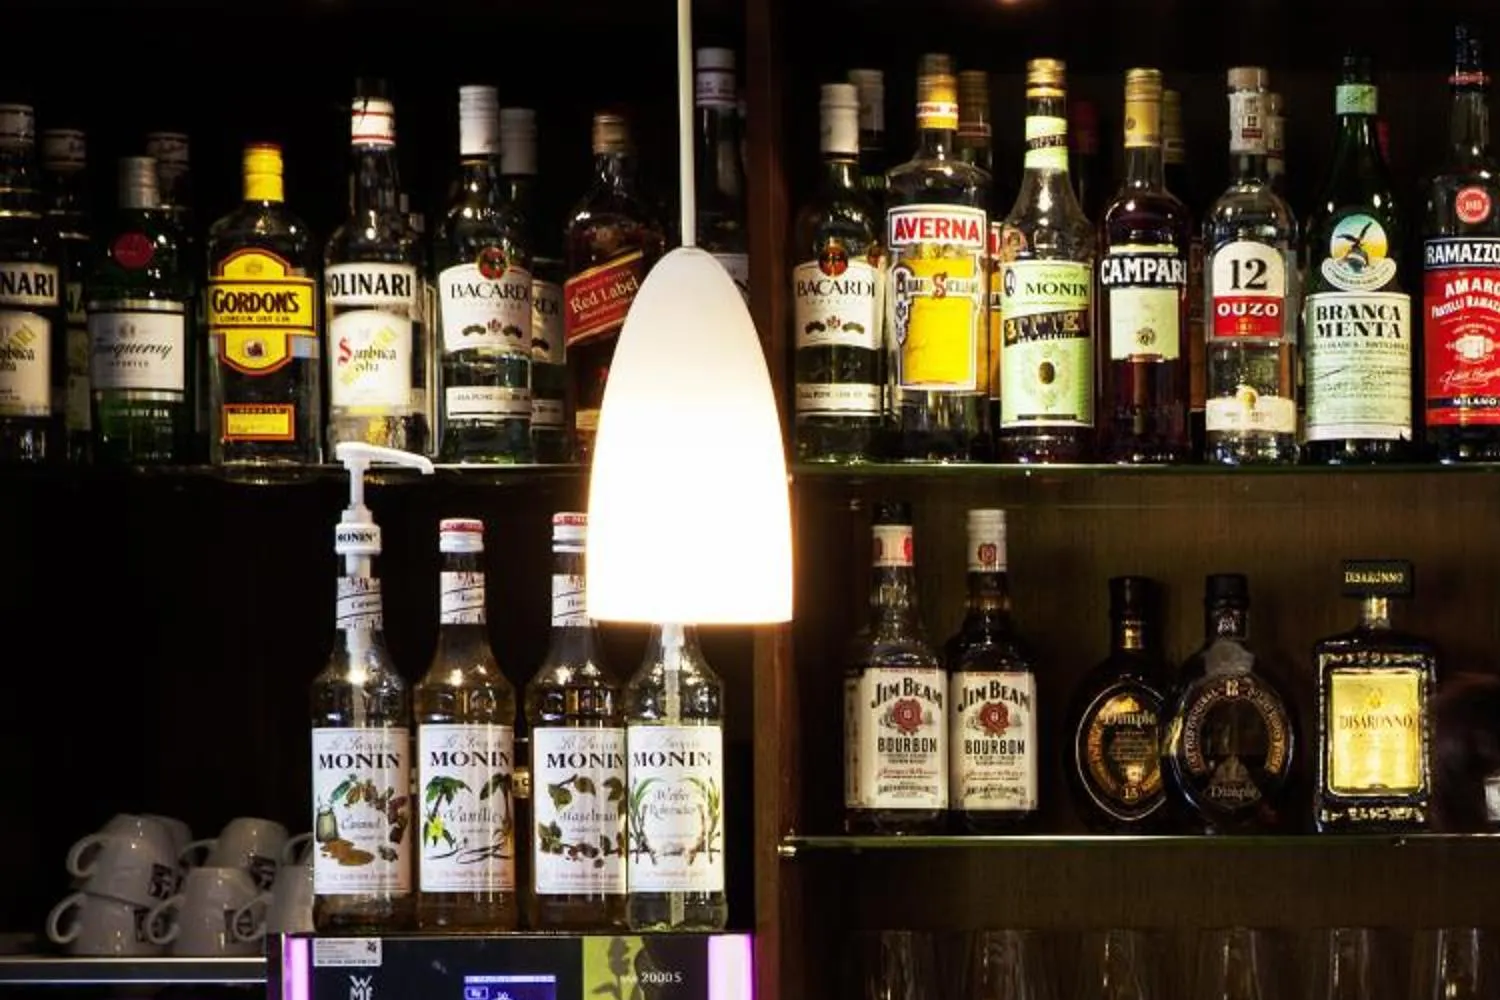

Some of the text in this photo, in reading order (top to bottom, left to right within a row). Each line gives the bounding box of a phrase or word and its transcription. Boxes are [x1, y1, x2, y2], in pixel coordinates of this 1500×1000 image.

[894, 217, 980, 242] AVERNA
[1101, 257, 1187, 285] CAMPARI
[1229, 257, 1268, 290] 12
[328, 273, 412, 297] OLINARI
[797, 279, 876, 299] BACARDI
[1025, 282, 1088, 297] MONIN
[570, 291, 599, 314] Red
[600, 275, 639, 302] Label
[1217, 302, 1279, 317] OUZO
[1316, 303, 1401, 321] BRANCA
[1316, 322, 1401, 339] MENTA
[1344, 570, 1404, 584] DISARONNO
[871, 677, 943, 711] JIM BEAM
[957, 680, 1031, 712] JIM BEAM
[1339, 715, 1413, 730] DISARONNO
[877, 737, 938, 754] BOURBON
[964, 739, 1025, 755] BOURBON
[318, 752, 400, 770] MONIN
[430, 751, 511, 768] MONIN
[546, 752, 624, 769] MONIN
[633, 751, 712, 768] MONIN
[641, 971, 673, 983] 2000
